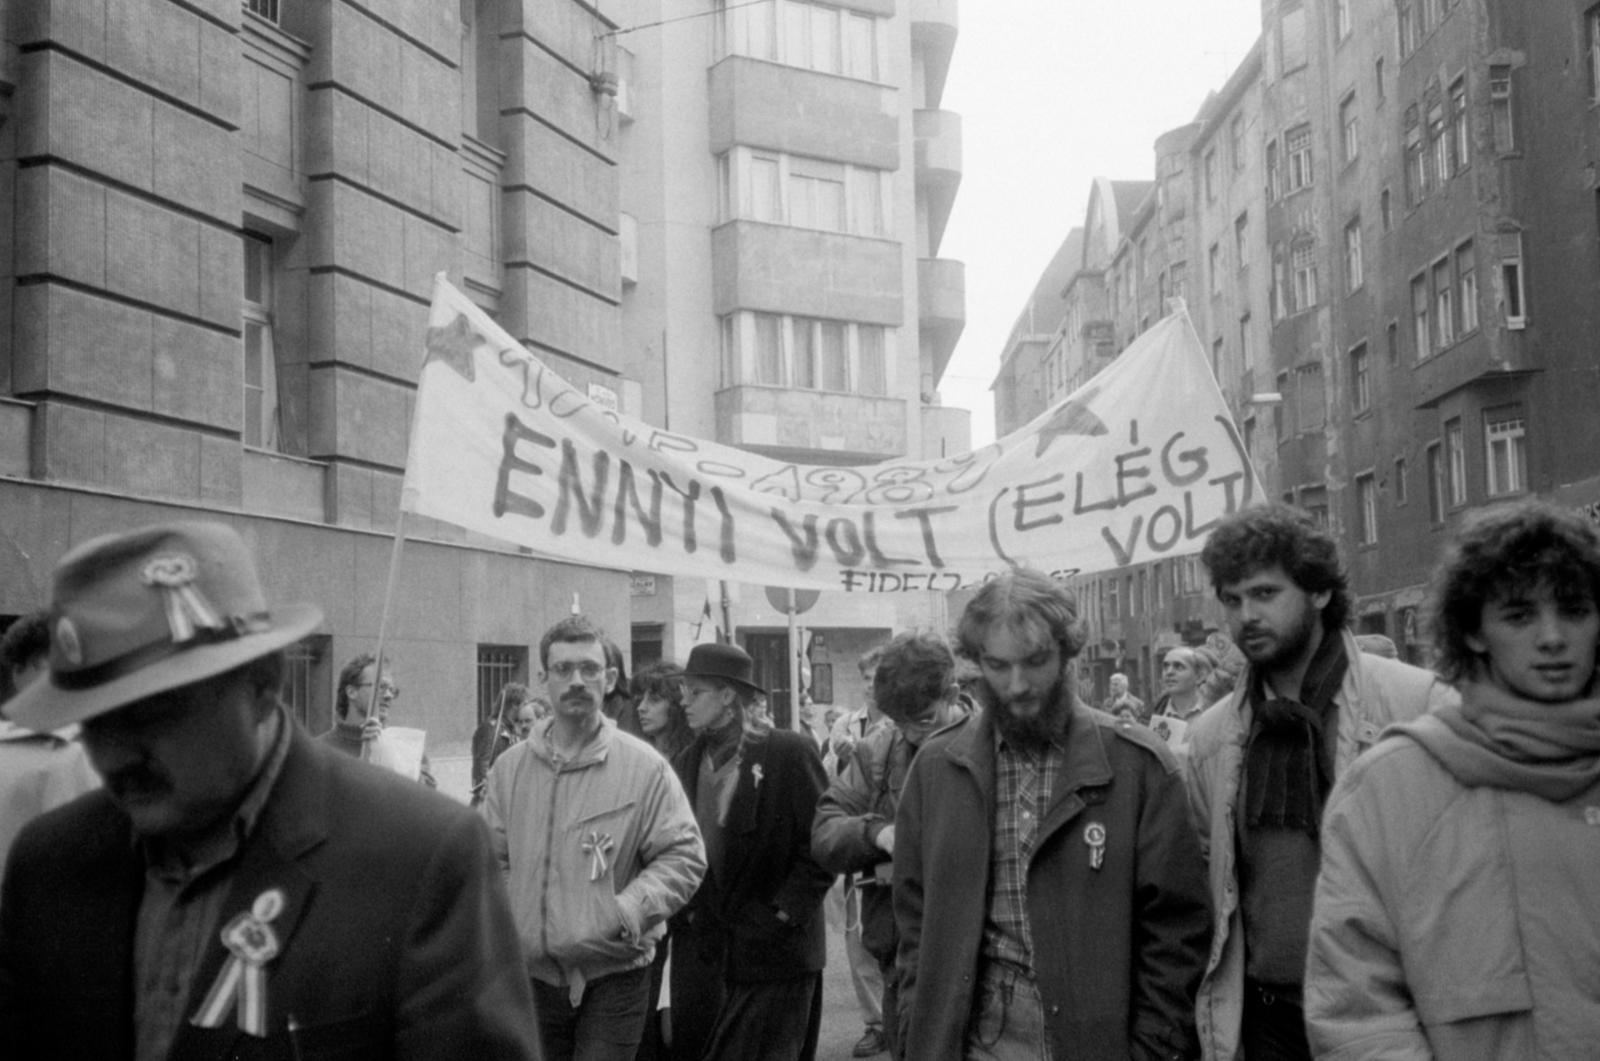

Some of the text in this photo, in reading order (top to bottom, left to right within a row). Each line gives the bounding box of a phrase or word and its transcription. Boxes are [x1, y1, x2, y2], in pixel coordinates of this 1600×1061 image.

[493, 411, 736, 564] ENNYI
[770, 505, 959, 571] VOLT
[988, 418, 1209, 567] (ELÉG
